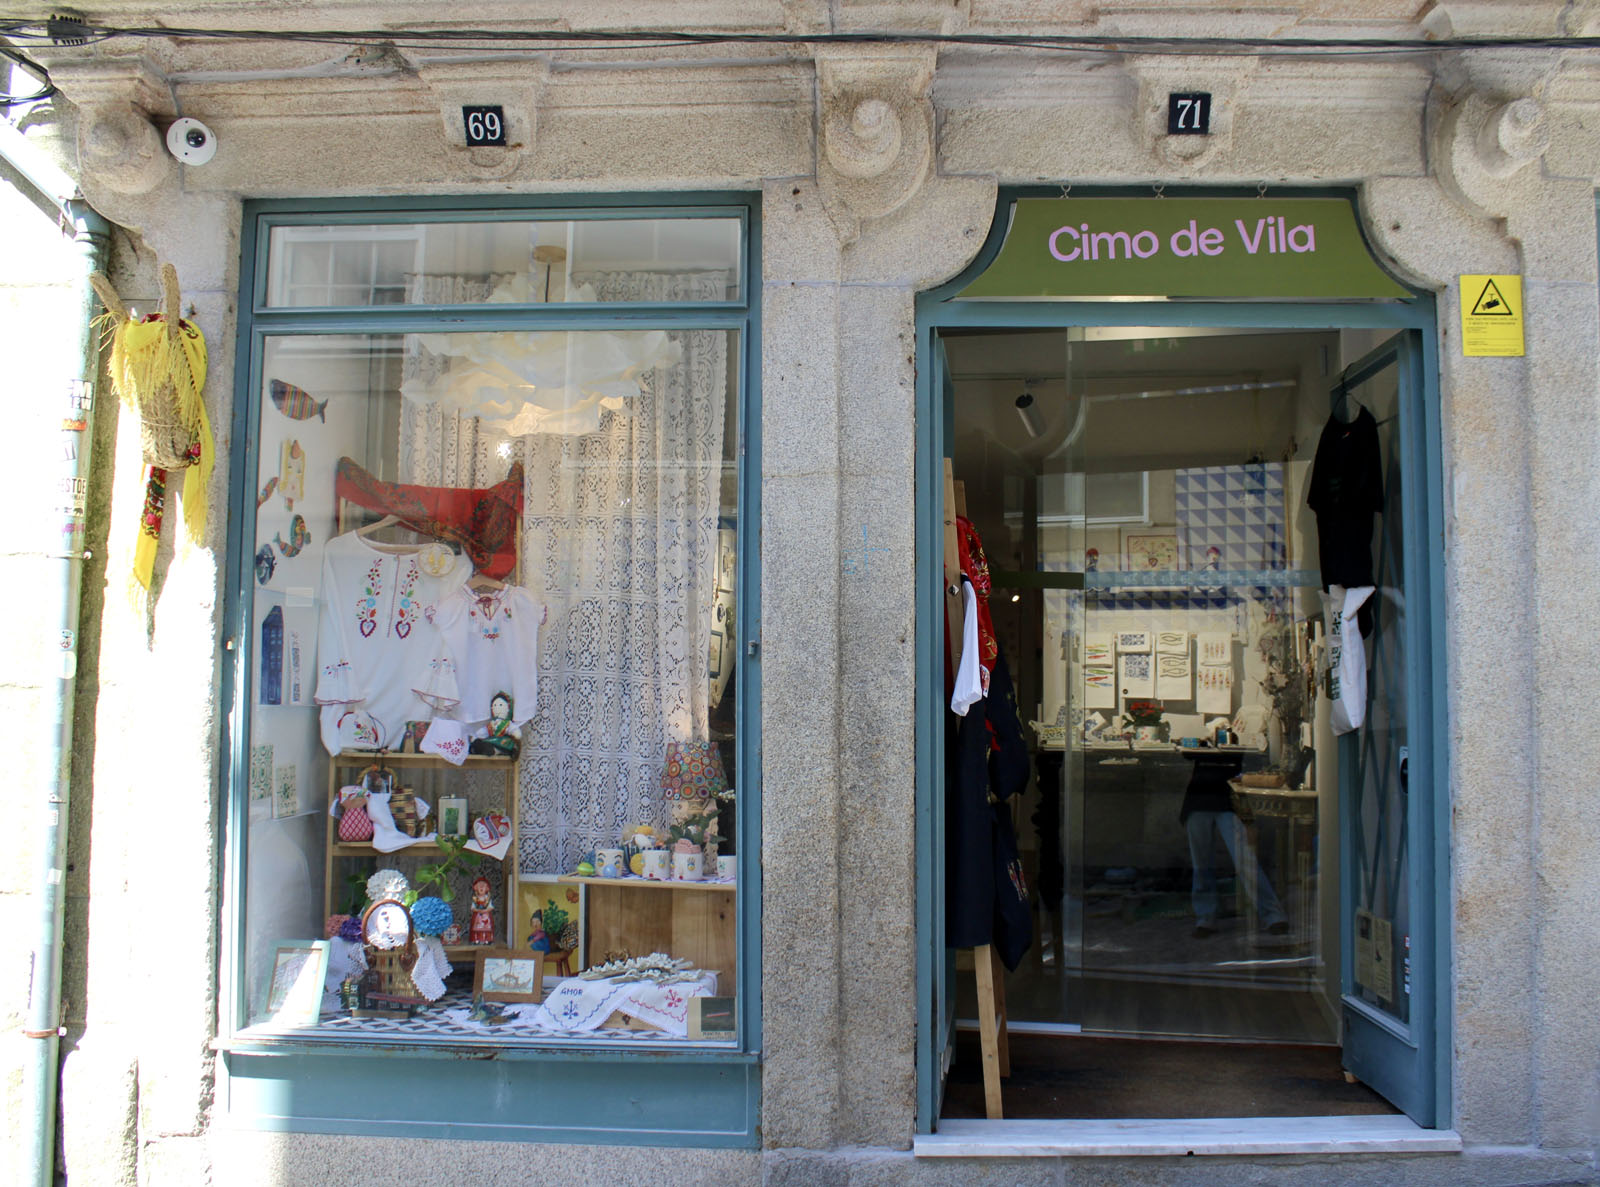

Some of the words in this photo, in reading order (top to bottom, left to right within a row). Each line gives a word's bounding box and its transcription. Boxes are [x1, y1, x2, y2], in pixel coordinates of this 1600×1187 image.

[468, 112, 501, 141] 69
[1177, 99, 1202, 129] 71
[1048, 223, 1160, 262] Cimo
[1170, 219, 1225, 258] de
[1234, 215, 1316, 254] Vila
